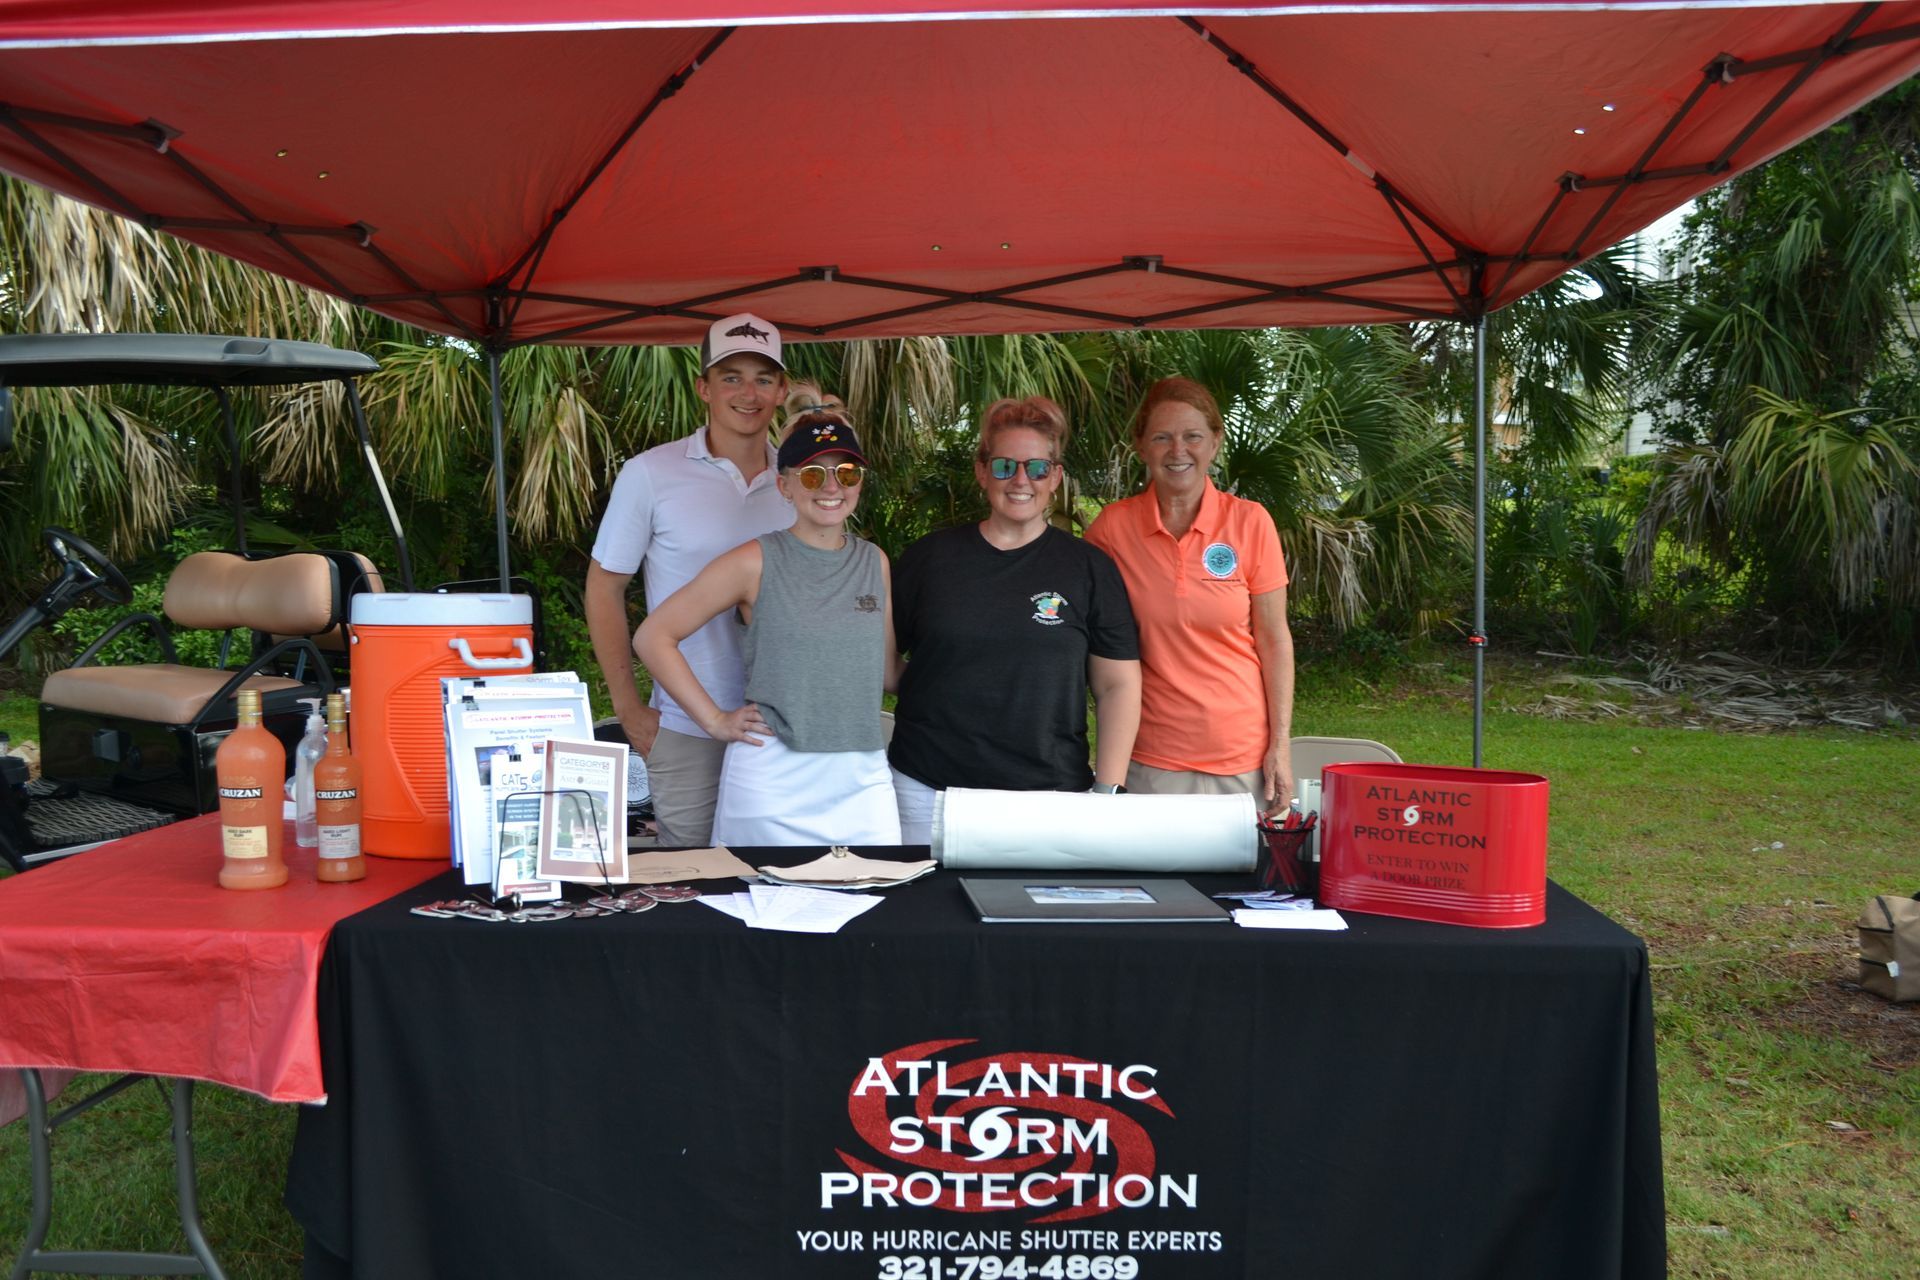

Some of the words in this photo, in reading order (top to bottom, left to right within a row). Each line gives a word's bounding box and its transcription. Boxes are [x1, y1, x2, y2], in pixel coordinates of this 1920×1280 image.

[220, 788, 261, 798] CRUZAN
[316, 790, 356, 799] CRUZAN
[1366, 785, 1472, 807] ATLANTIC
[1377, 805, 1454, 826] STORM
[1354, 825, 1487, 849] PROTECTION
[1367, 854, 1413, 869] ENTER
[1418, 859, 1436, 871] TO
[1440, 861, 1469, 873] WIN
[1370, 871, 1380, 881] A
[1383, 871, 1421, 885] DOOR
[1424, 876, 1467, 889] PRIZE
[853, 1057, 1158, 1100] ATLANTIC
[889, 1106, 1108, 1161] STORM
[820, 1171, 1198, 1209] PROTECTION
[797, 1230, 865, 1251] YOUR
[873, 1229, 1011, 1251] HURRICANE
[1020, 1229, 1119, 1251] SHUTTER
[1128, 1231, 1222, 1251] EXPERTS
[877, 1254, 1140, 1280] 321-794-4869
